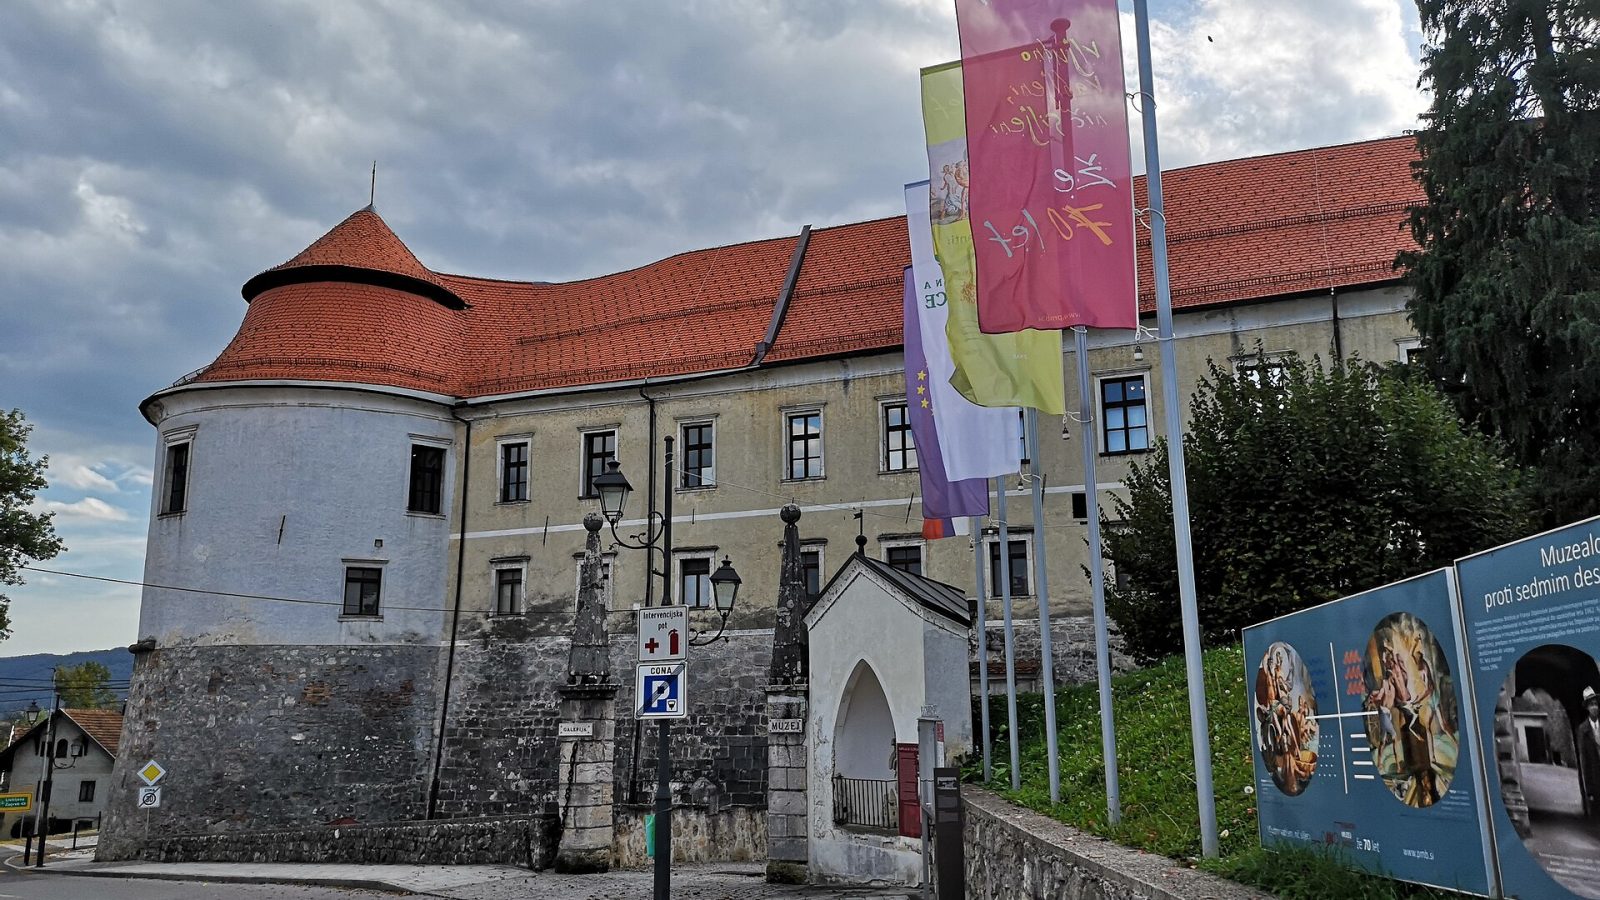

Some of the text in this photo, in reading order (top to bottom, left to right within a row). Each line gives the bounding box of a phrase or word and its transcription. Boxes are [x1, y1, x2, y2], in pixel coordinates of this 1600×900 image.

[1484, 583, 1513, 612] proti
[1515, 573, 1570, 601] sedmim
[643, 610, 683, 619] Intervencijska
[658, 622, 668, 631] pot
[650, 666, 672, 675] CONA
[771, 721, 800, 731] MUZEJ
[1363, 838, 1371, 851] 70
